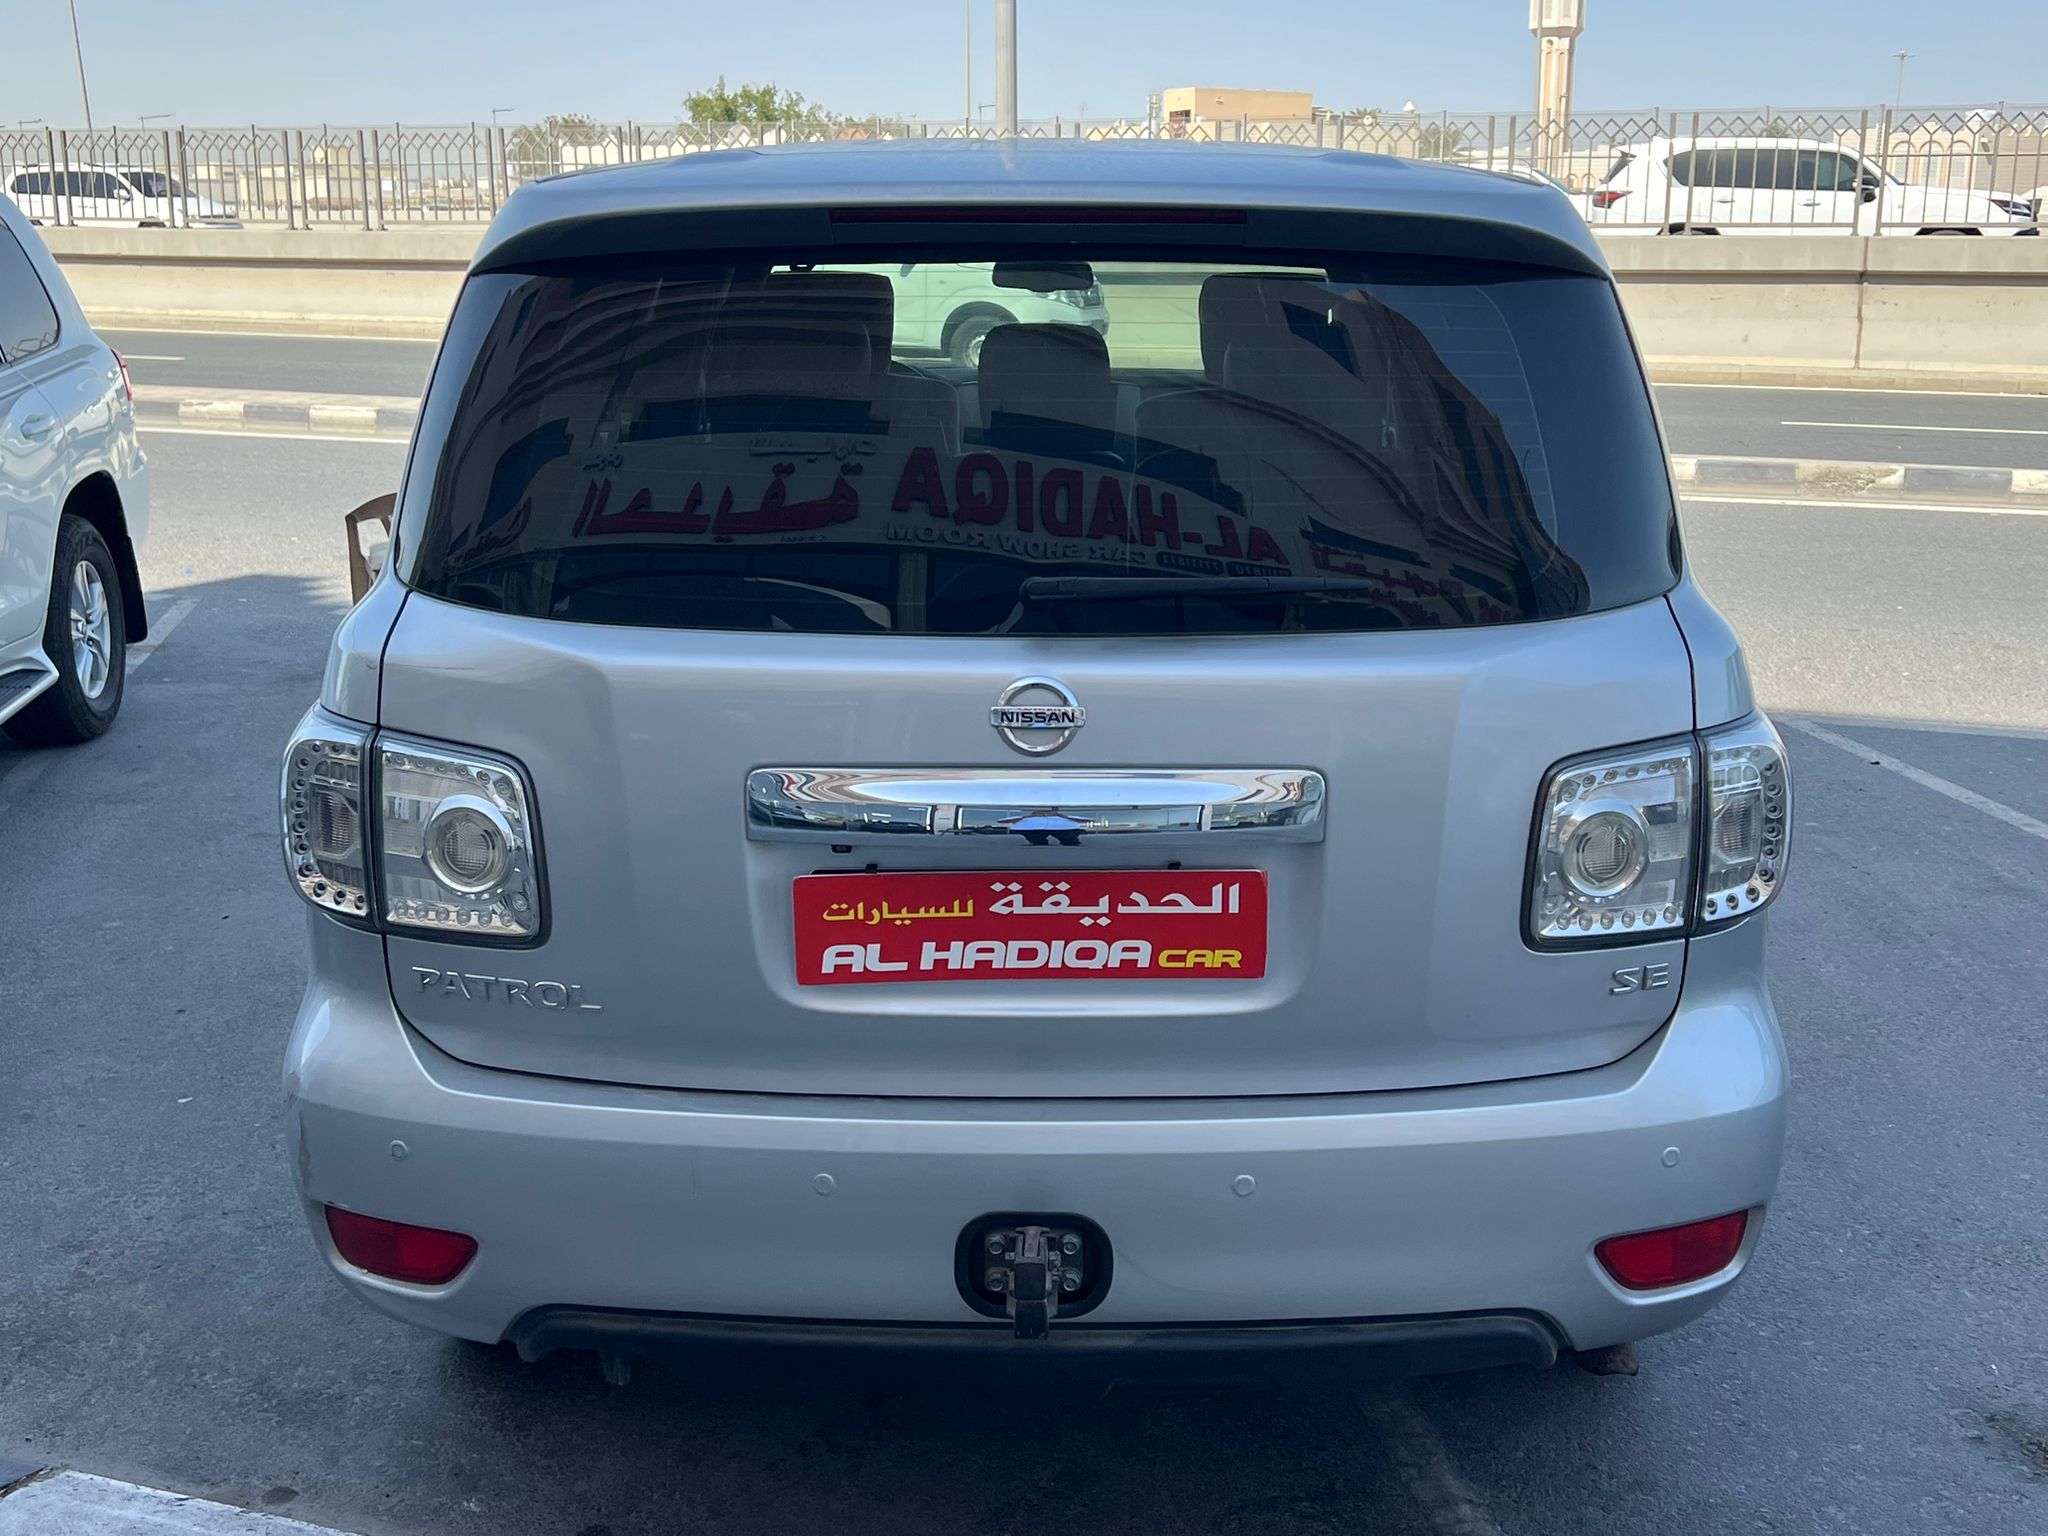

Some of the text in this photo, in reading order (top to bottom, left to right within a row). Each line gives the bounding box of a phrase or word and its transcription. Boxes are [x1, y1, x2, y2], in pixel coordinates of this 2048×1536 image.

[1000, 711, 1075, 723] NISSAN
[822, 881, 1240, 927] الحديقة للسيارات
[821, 939, 1243, 974] AL HADIQA CAR
[411, 965, 604, 1014] PATROL
[1609, 962, 1670, 995] SE
